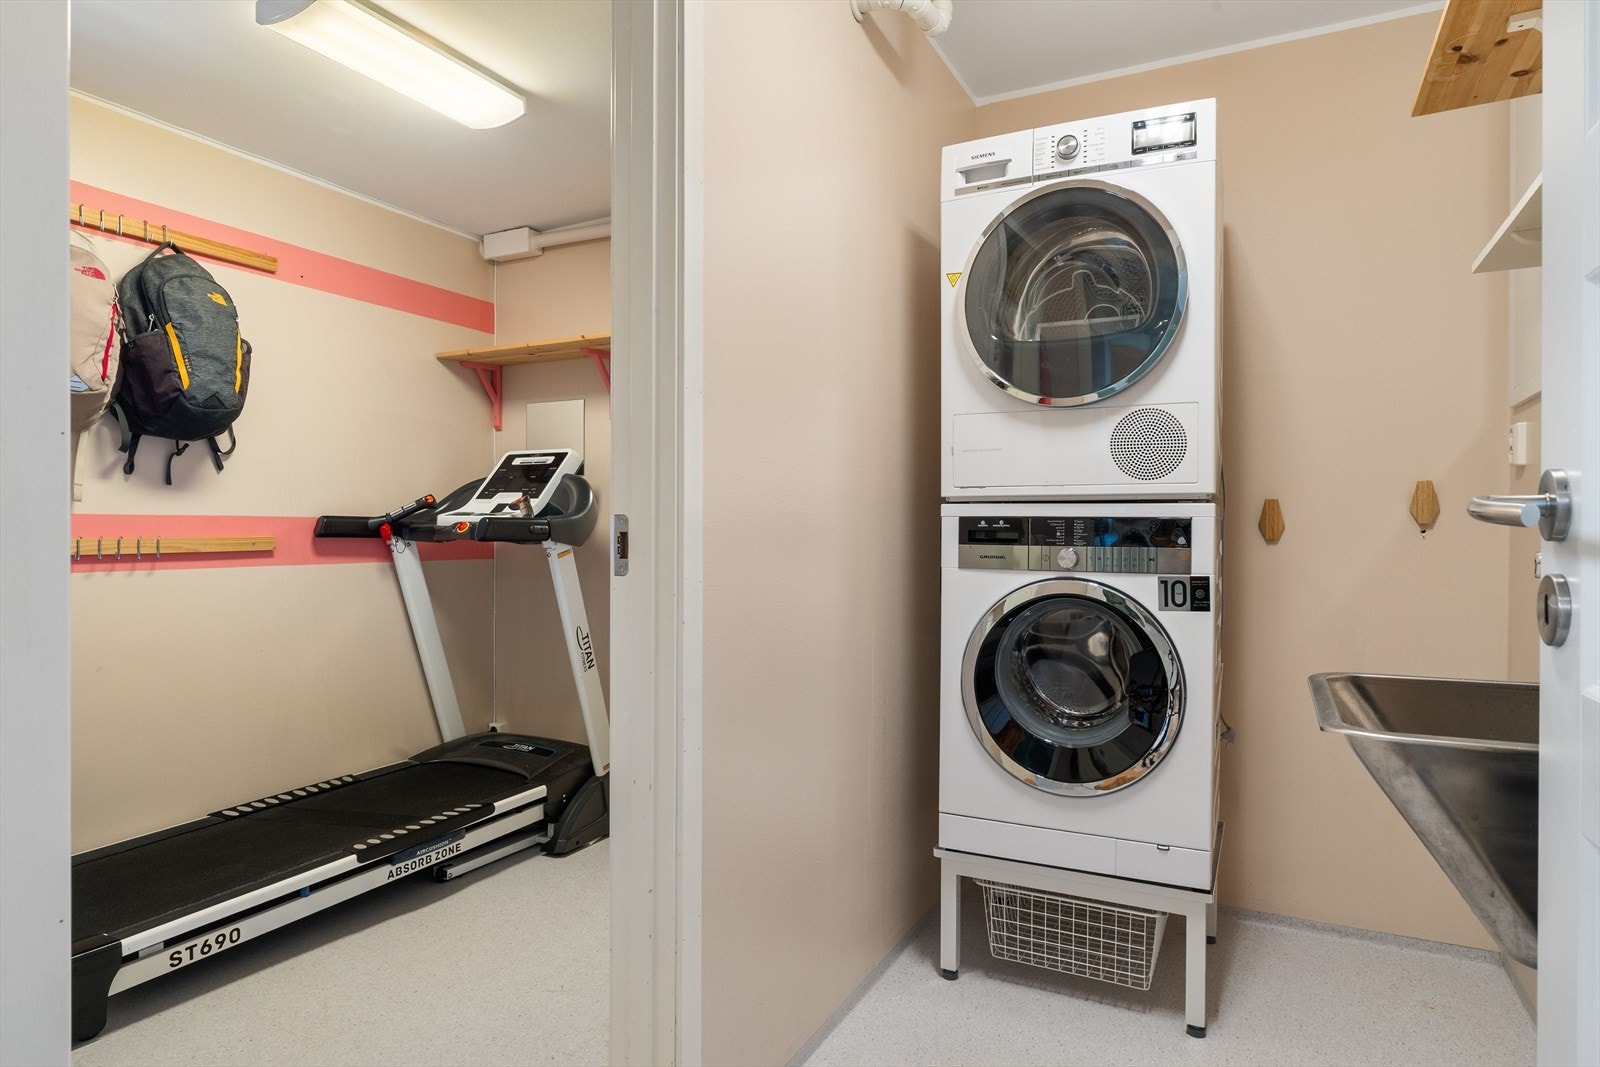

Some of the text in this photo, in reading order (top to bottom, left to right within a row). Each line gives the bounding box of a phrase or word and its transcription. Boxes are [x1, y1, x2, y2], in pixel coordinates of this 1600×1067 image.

[971, 151, 996, 161] SIEMENS
[1160, 579, 1187, 608] 10
[581, 632, 595, 670] TITAN
[387, 842, 461, 881] ABSORB ZONE
[169, 927, 241, 968] ST690
